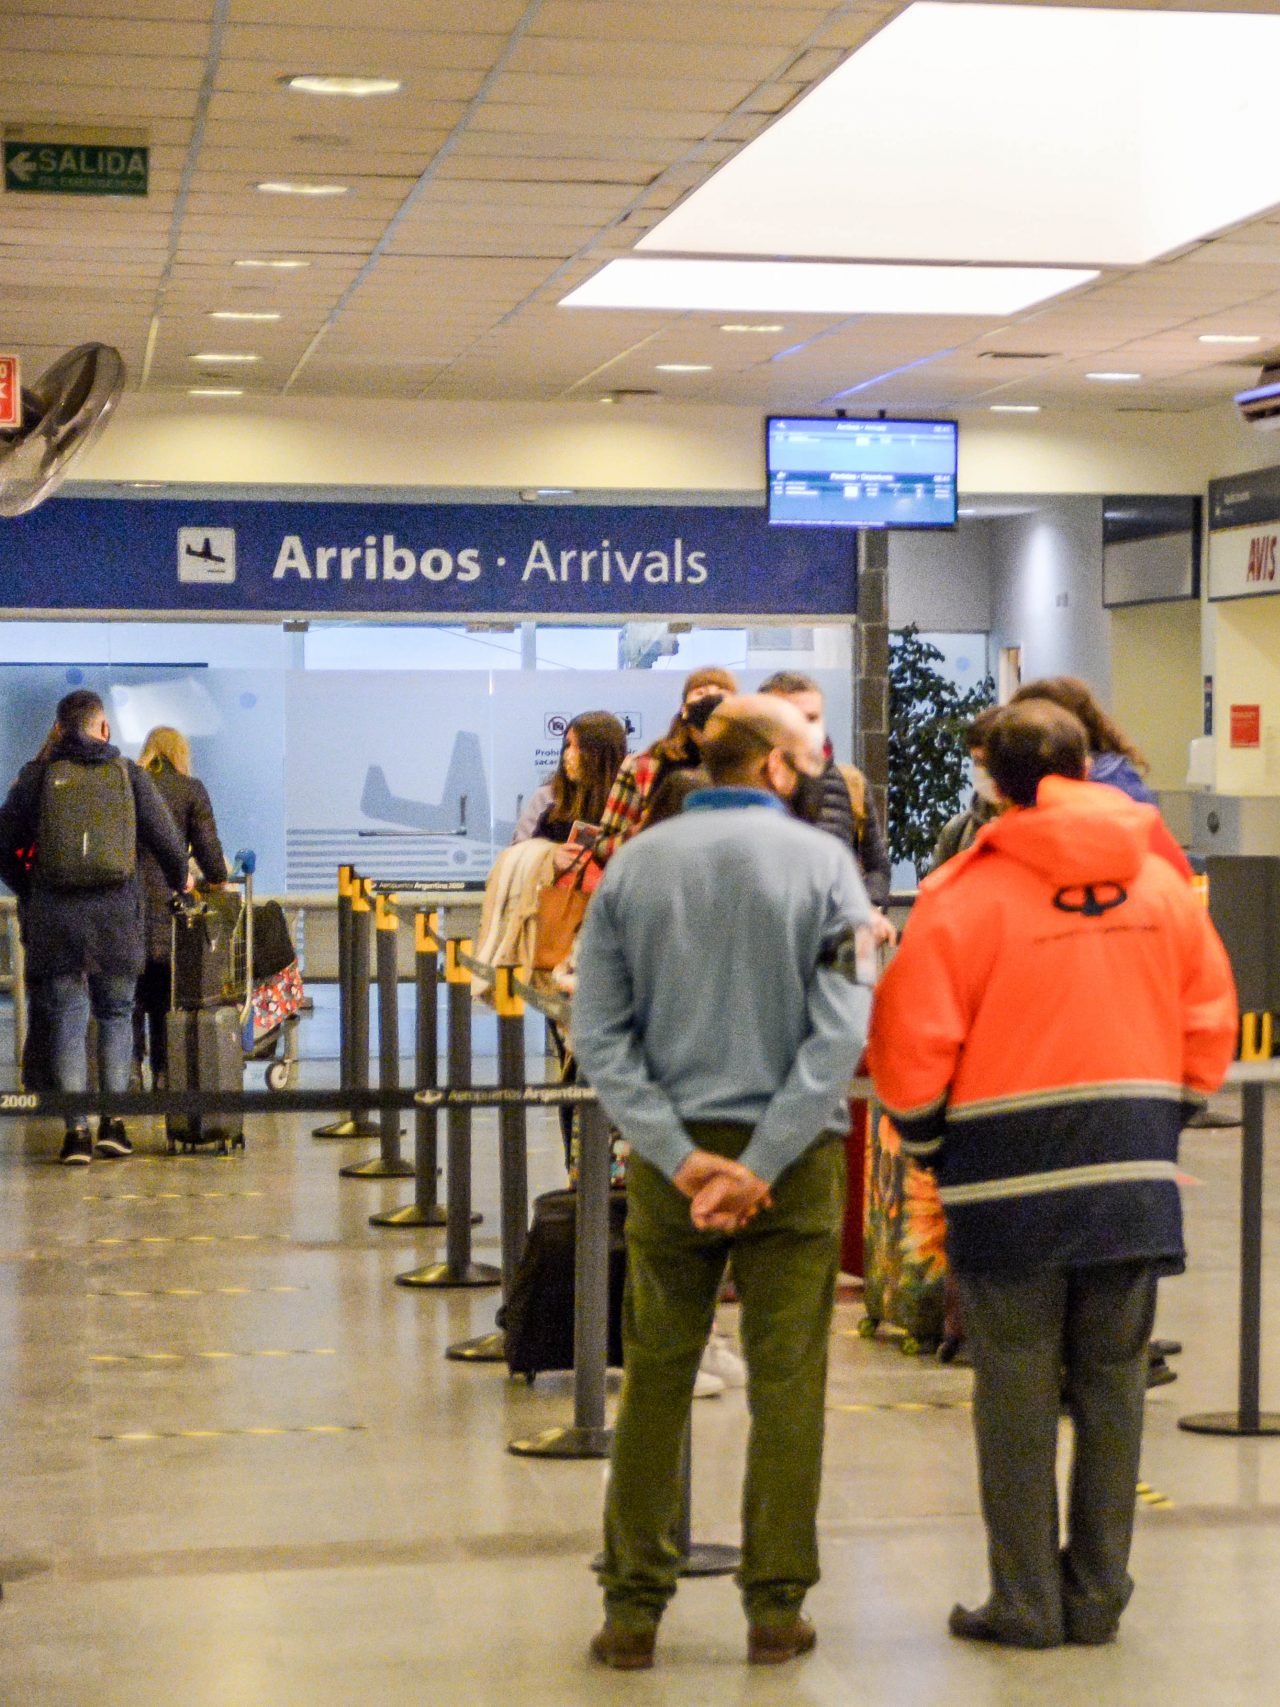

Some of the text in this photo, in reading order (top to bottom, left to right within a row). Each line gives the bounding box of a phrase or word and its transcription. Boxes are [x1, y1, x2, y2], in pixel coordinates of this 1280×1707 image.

[38, 149, 145, 175] SALIDA
[272, 534, 708, 584] Arribos Arrivals
[1246, 536, 1277, 582] AVIS
[414, 882, 448, 891] Argentina
[448, 882, 465, 890] 2000
[1, 1094, 37, 1108] 2000
